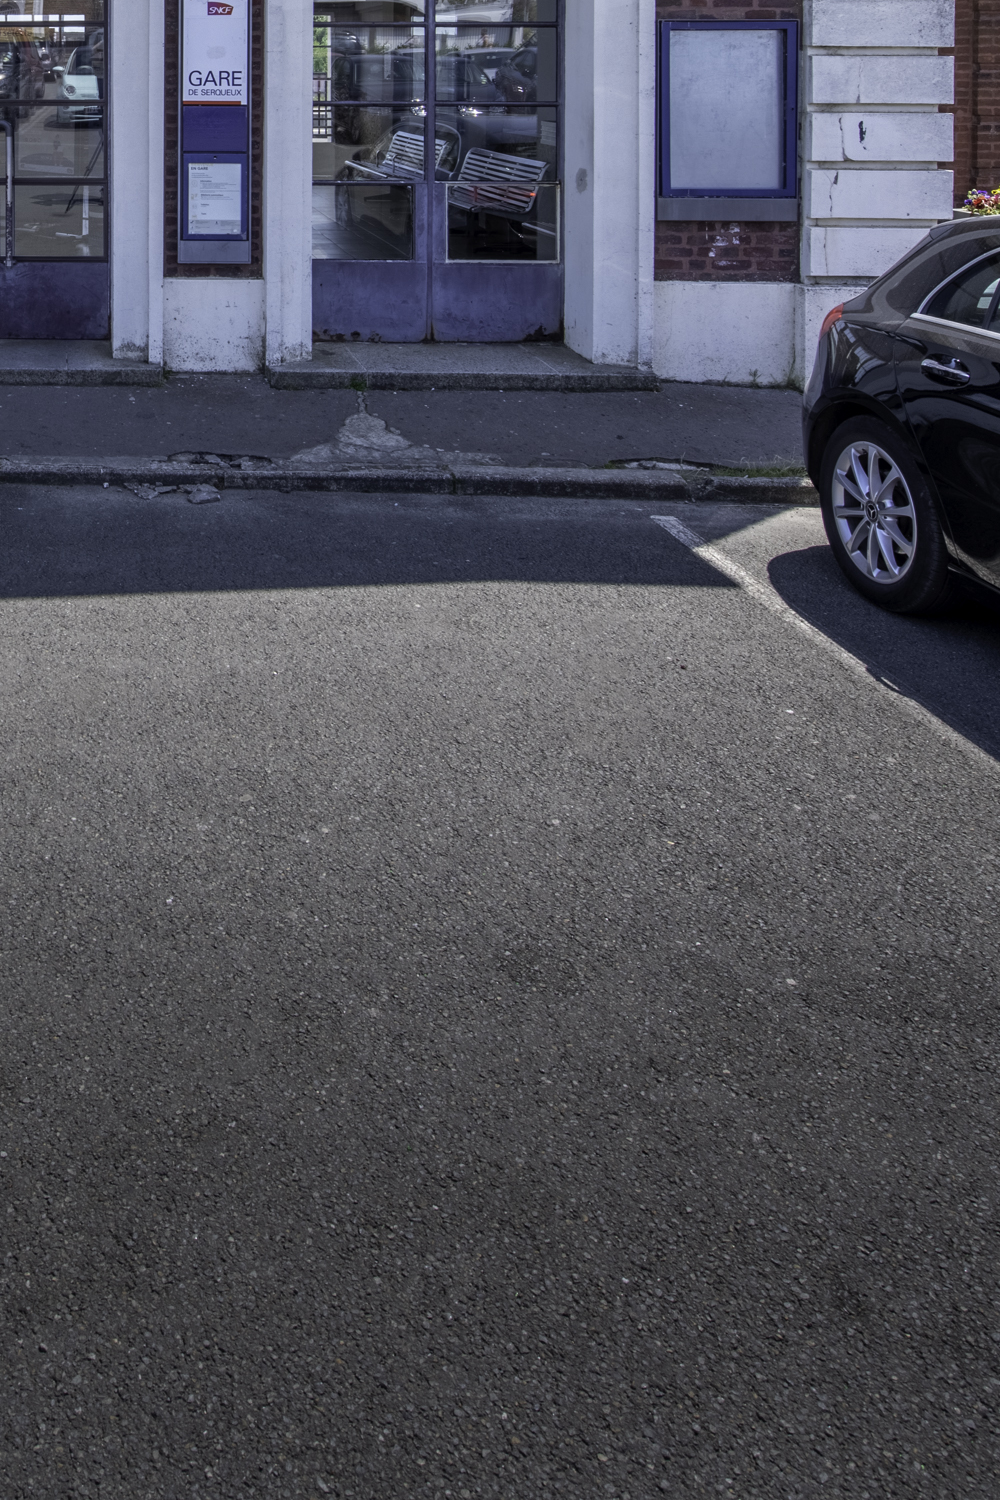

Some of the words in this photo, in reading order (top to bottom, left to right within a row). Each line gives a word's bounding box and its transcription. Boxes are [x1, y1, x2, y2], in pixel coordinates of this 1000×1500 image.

[208, 6, 232, 14] SNCF
[188, 70, 242, 87] GARE
[188, 88, 199, 96] DE
[200, 88, 242, 97] SERQUEUX
